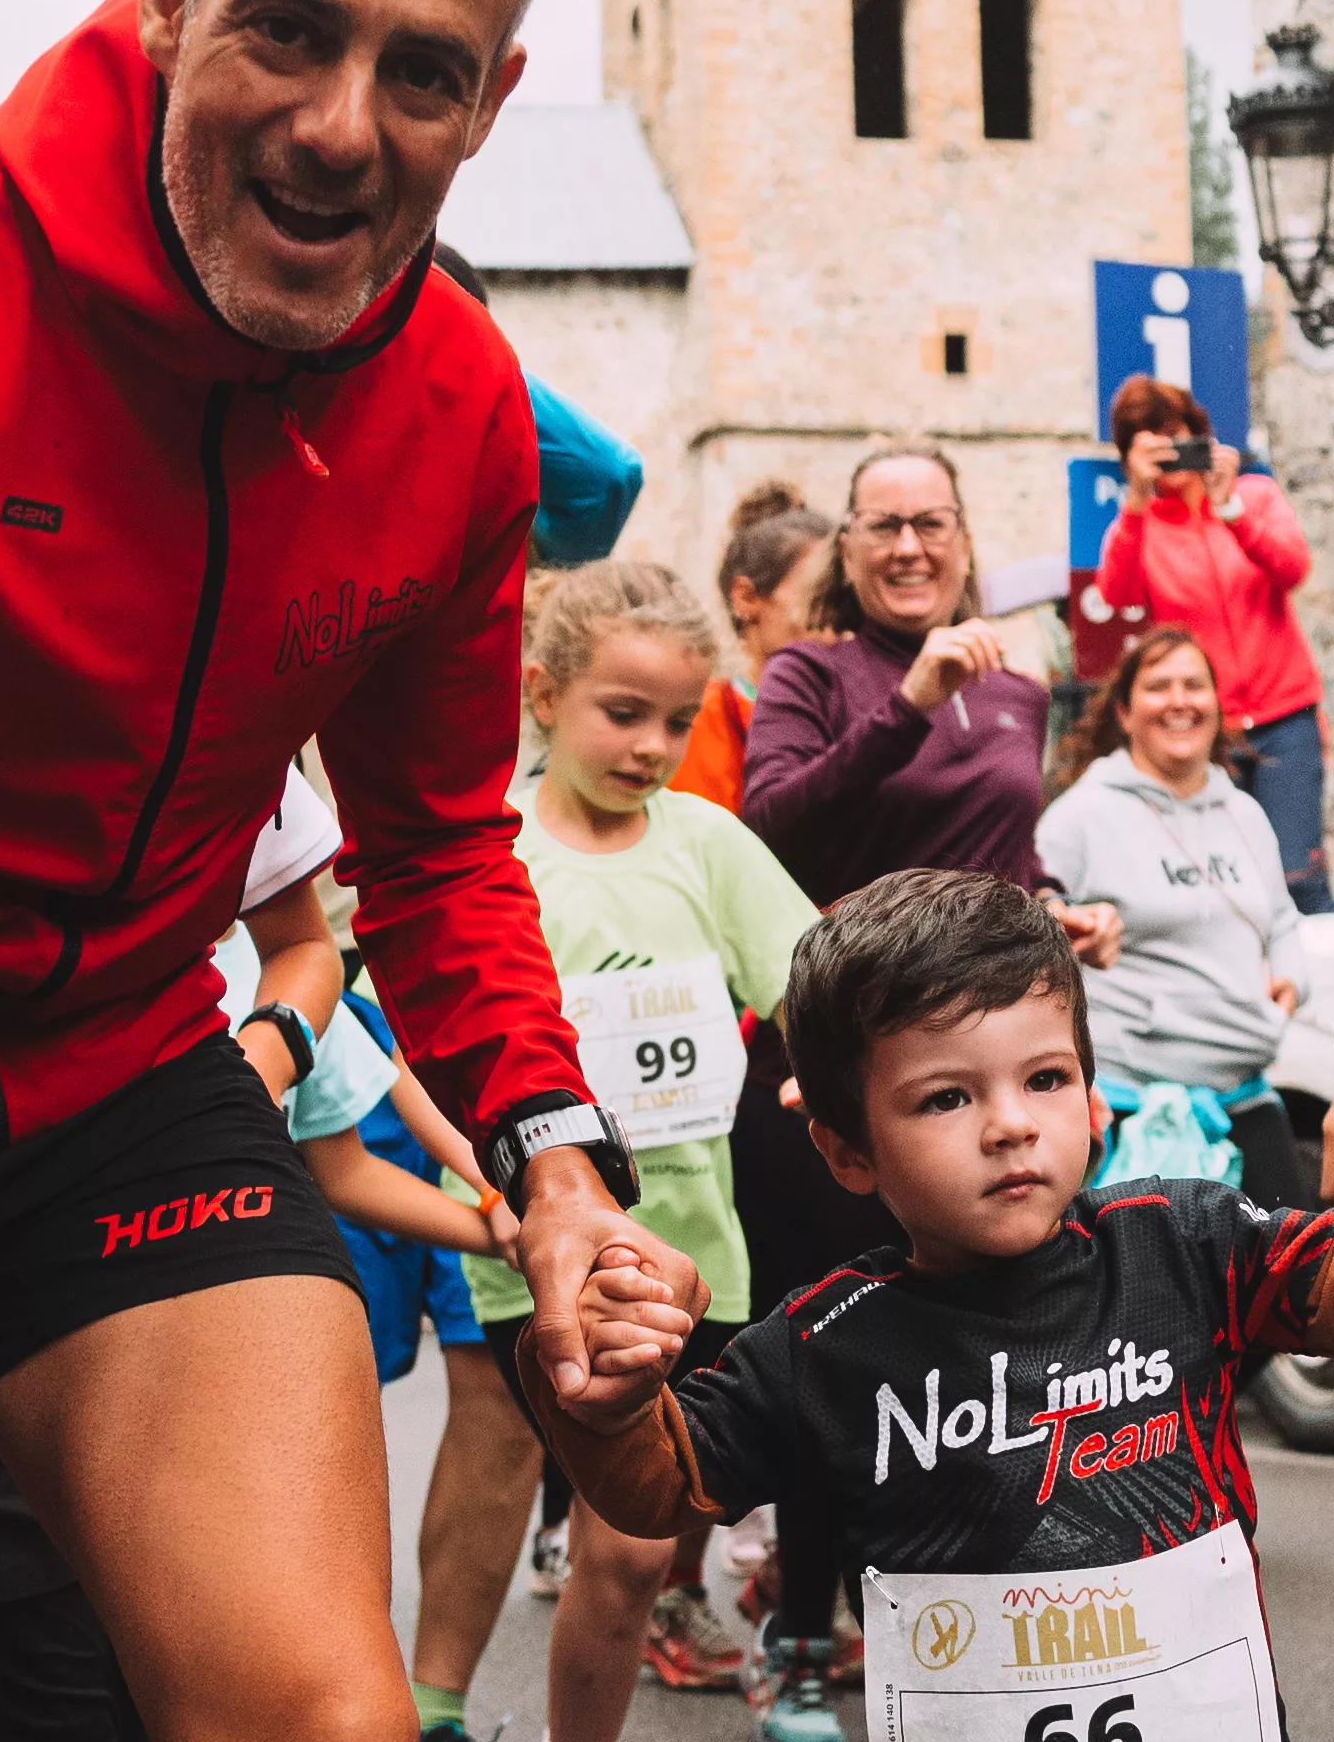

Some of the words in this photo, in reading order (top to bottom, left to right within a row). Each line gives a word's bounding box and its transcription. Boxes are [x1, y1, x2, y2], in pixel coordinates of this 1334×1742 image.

[635, 1036, 697, 1083] 99
[94, 1186, 274, 1258] HOKO
[1029, 1398, 1179, 1506] Team
[1003, 1576, 1133, 1608] mini
[1002, 1601, 1148, 1666] TRAIL
[1018, 1669, 1055, 1682] VALLE
[1060, 1667, 1076, 1679] DE
[1082, 1662, 1112, 1677] TENA
[885, 1683, 894, 1700] 138
[886, 1704, 894, 1721] 140
[888, 1724, 897, 1742] 614
